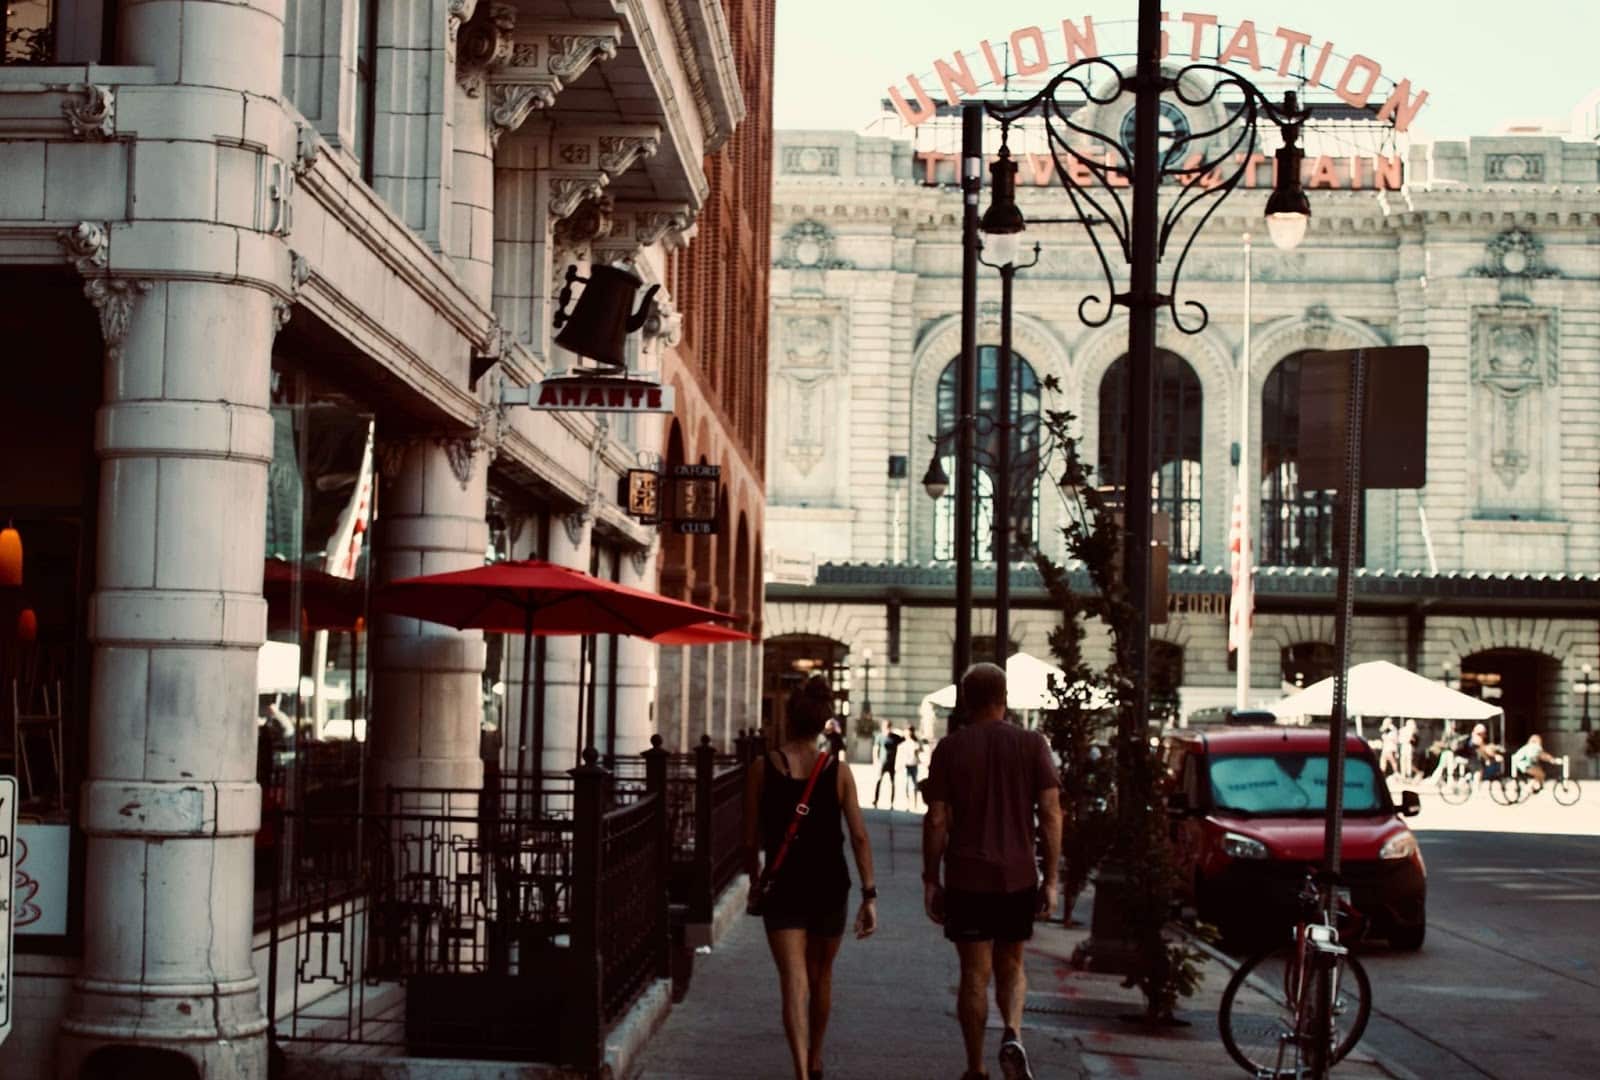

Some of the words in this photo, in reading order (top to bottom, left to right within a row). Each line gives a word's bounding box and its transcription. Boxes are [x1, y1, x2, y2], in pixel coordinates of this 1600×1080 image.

[888, 15, 1098, 127] UNION
[916, 152, 1130, 186] TVEL
[1235, 152, 1403, 189] TAIN
[538, 384, 662, 408] AMANTE
[681, 523, 711, 534] CLUB
